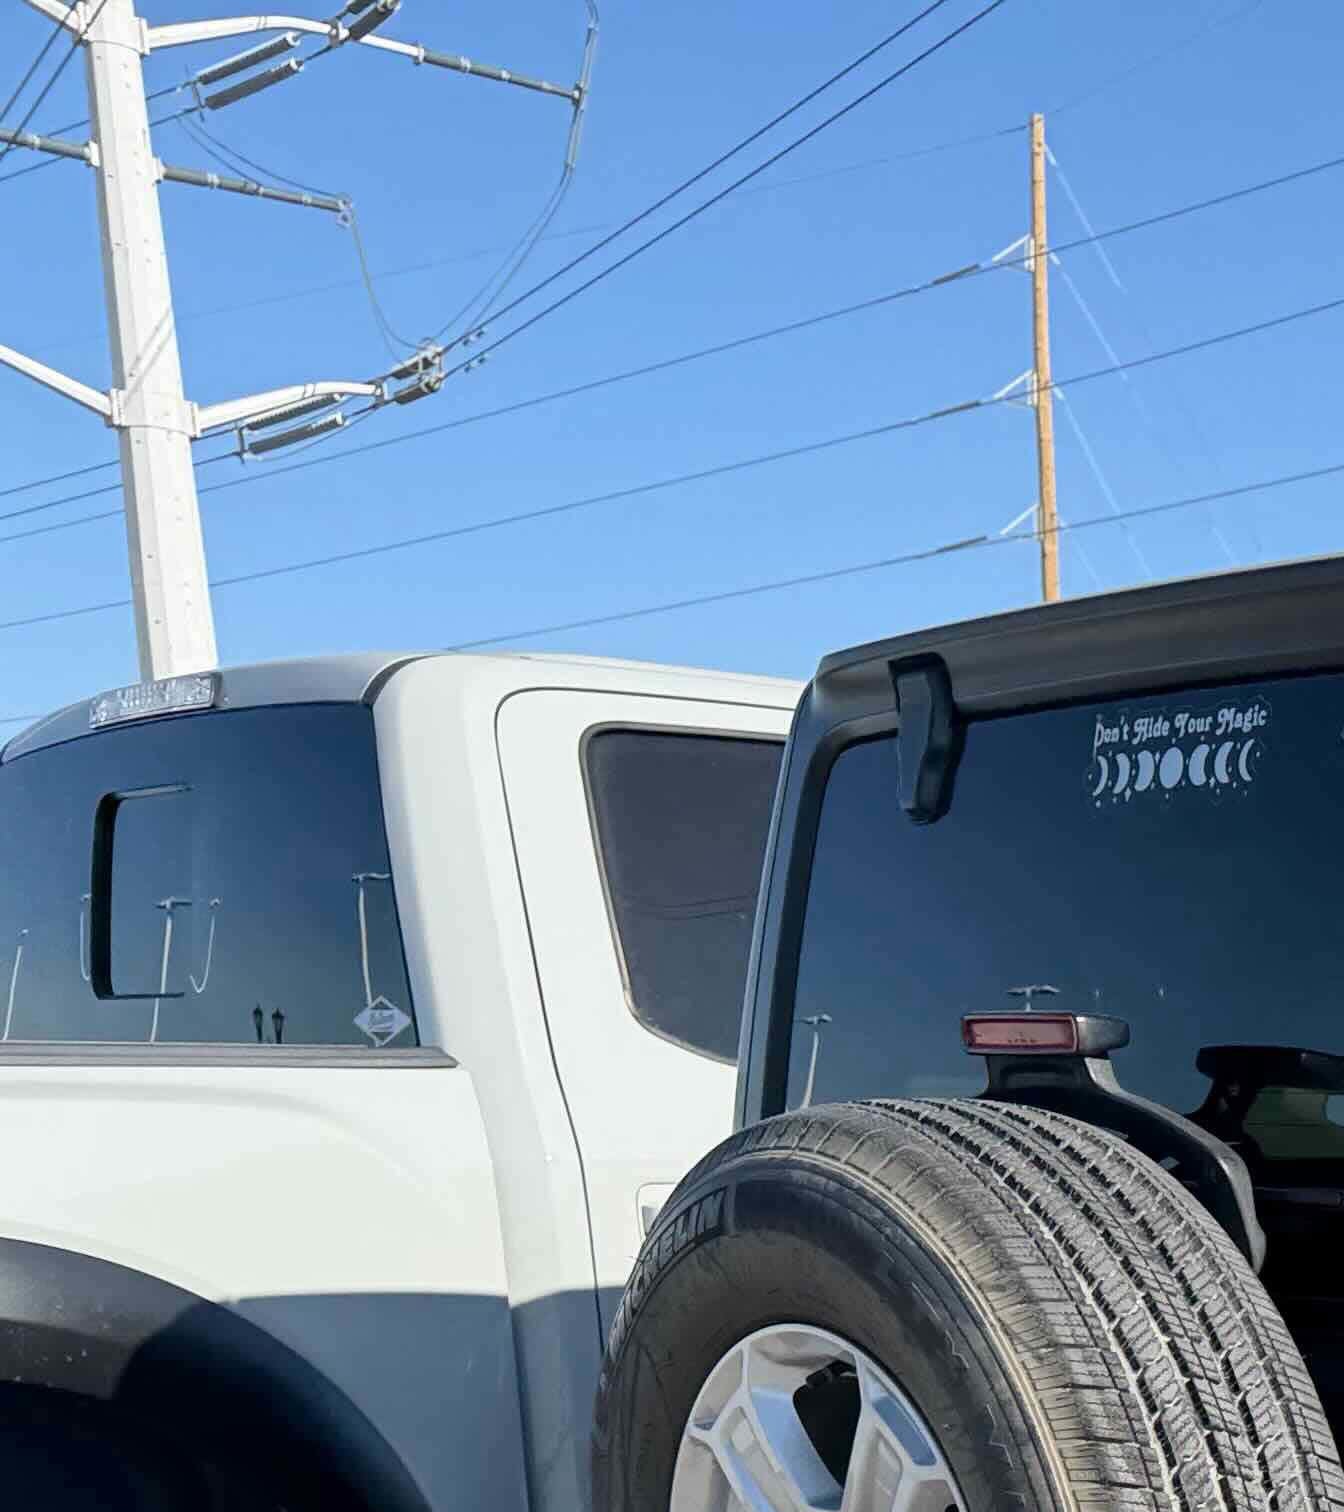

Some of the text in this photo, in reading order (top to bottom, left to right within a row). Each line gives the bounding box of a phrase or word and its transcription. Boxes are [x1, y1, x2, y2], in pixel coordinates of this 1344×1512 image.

[1093, 704, 1267, 748] Don't Hide Your Magic
